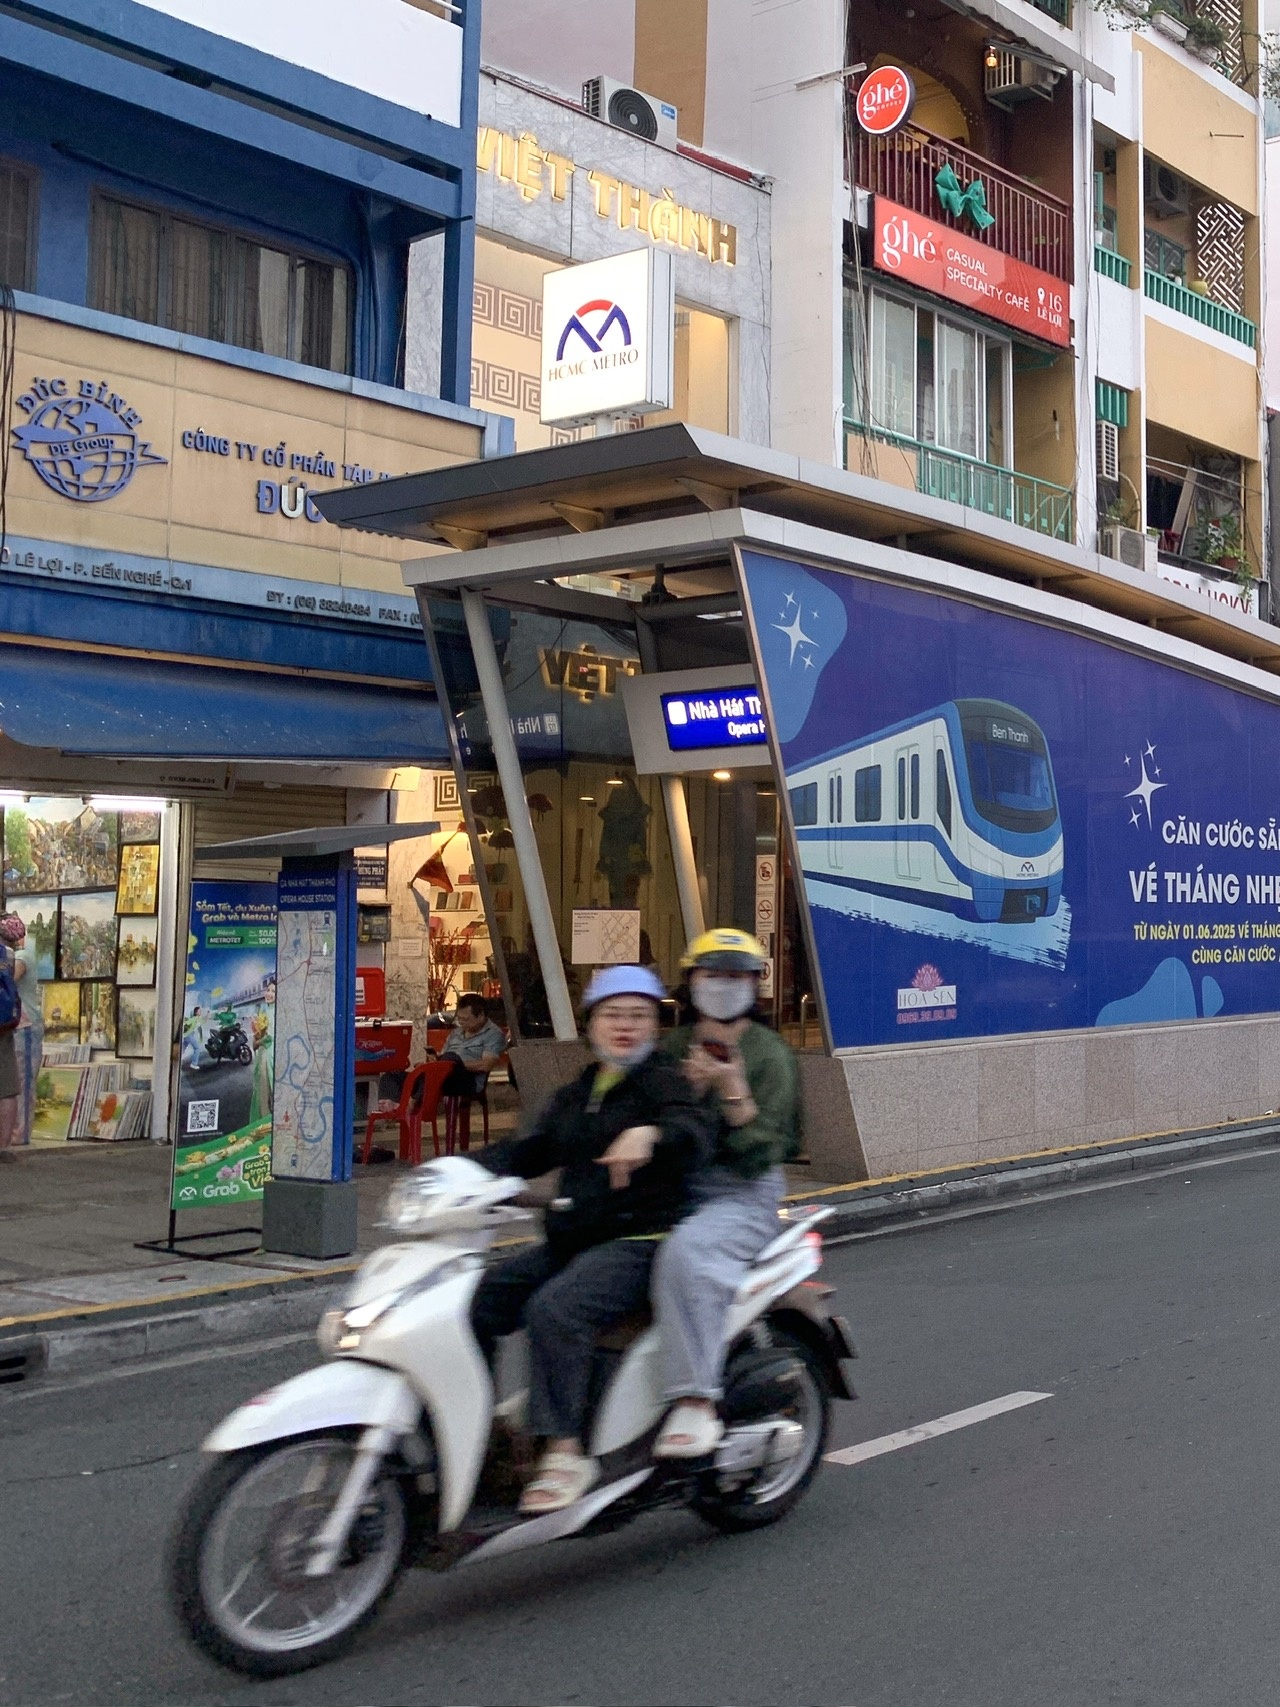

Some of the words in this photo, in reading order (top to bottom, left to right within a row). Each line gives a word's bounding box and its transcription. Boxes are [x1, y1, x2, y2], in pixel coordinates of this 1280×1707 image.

[476, 126, 575, 202] VIỆT
[587, 170, 737, 267] THÀNH
[946, 248, 988, 276] CASUAL
[946, 267, 1003, 301] SPECIALTY
[1005, 291, 1030, 313] CAFÉ
[1048, 292, 1062, 312] 16
[549, 360, 588, 381] HCMC
[592, 349, 639, 370] METRO
[73, 438, 115, 453] Group
[183, 427, 230, 456] CÔNG
[236, 442, 258, 461] TY
[15, 552, 34, 568] LÊ
[38, 557, 63, 575] LỢI
[92, 562, 121, 581] BẾN
[123, 570, 163, 587] NGHÉ
[379, 607, 402, 622] FAX
[688, 700, 719, 720] Nhà
[719, 698, 744, 717] Hát
[728, 721, 759, 739] Opera
[992, 723, 1007, 739] Ben
[1162, 815, 1200, 846] CĂN
[1205, 819, 1254, 848] CƯỚC
[1129, 862, 1158, 903] VÉ
[1164, 863, 1240, 905] THÁNG
[202, 913, 226, 923] Grab
[241, 913, 269, 921] Metro
[209, 936, 242, 944] METROTET
[1134, 920, 1147, 940] TỪ
[1150, 922, 1180, 940] NGÀY
[1183, 924, 1235, 940] 01.06.2025
[1238, 921, 1249, 939] VÉ
[1192, 946, 1221, 964] CÙNG
[1224, 945, 1245, 963] CĂN
[1248, 944, 1276, 962] CƯỚC
[899, 992, 928, 1007] HOA
[933, 990, 955, 1004] SEN
[245, 1159, 265, 1170] Grab
[203, 1181, 240, 1198] Grab
